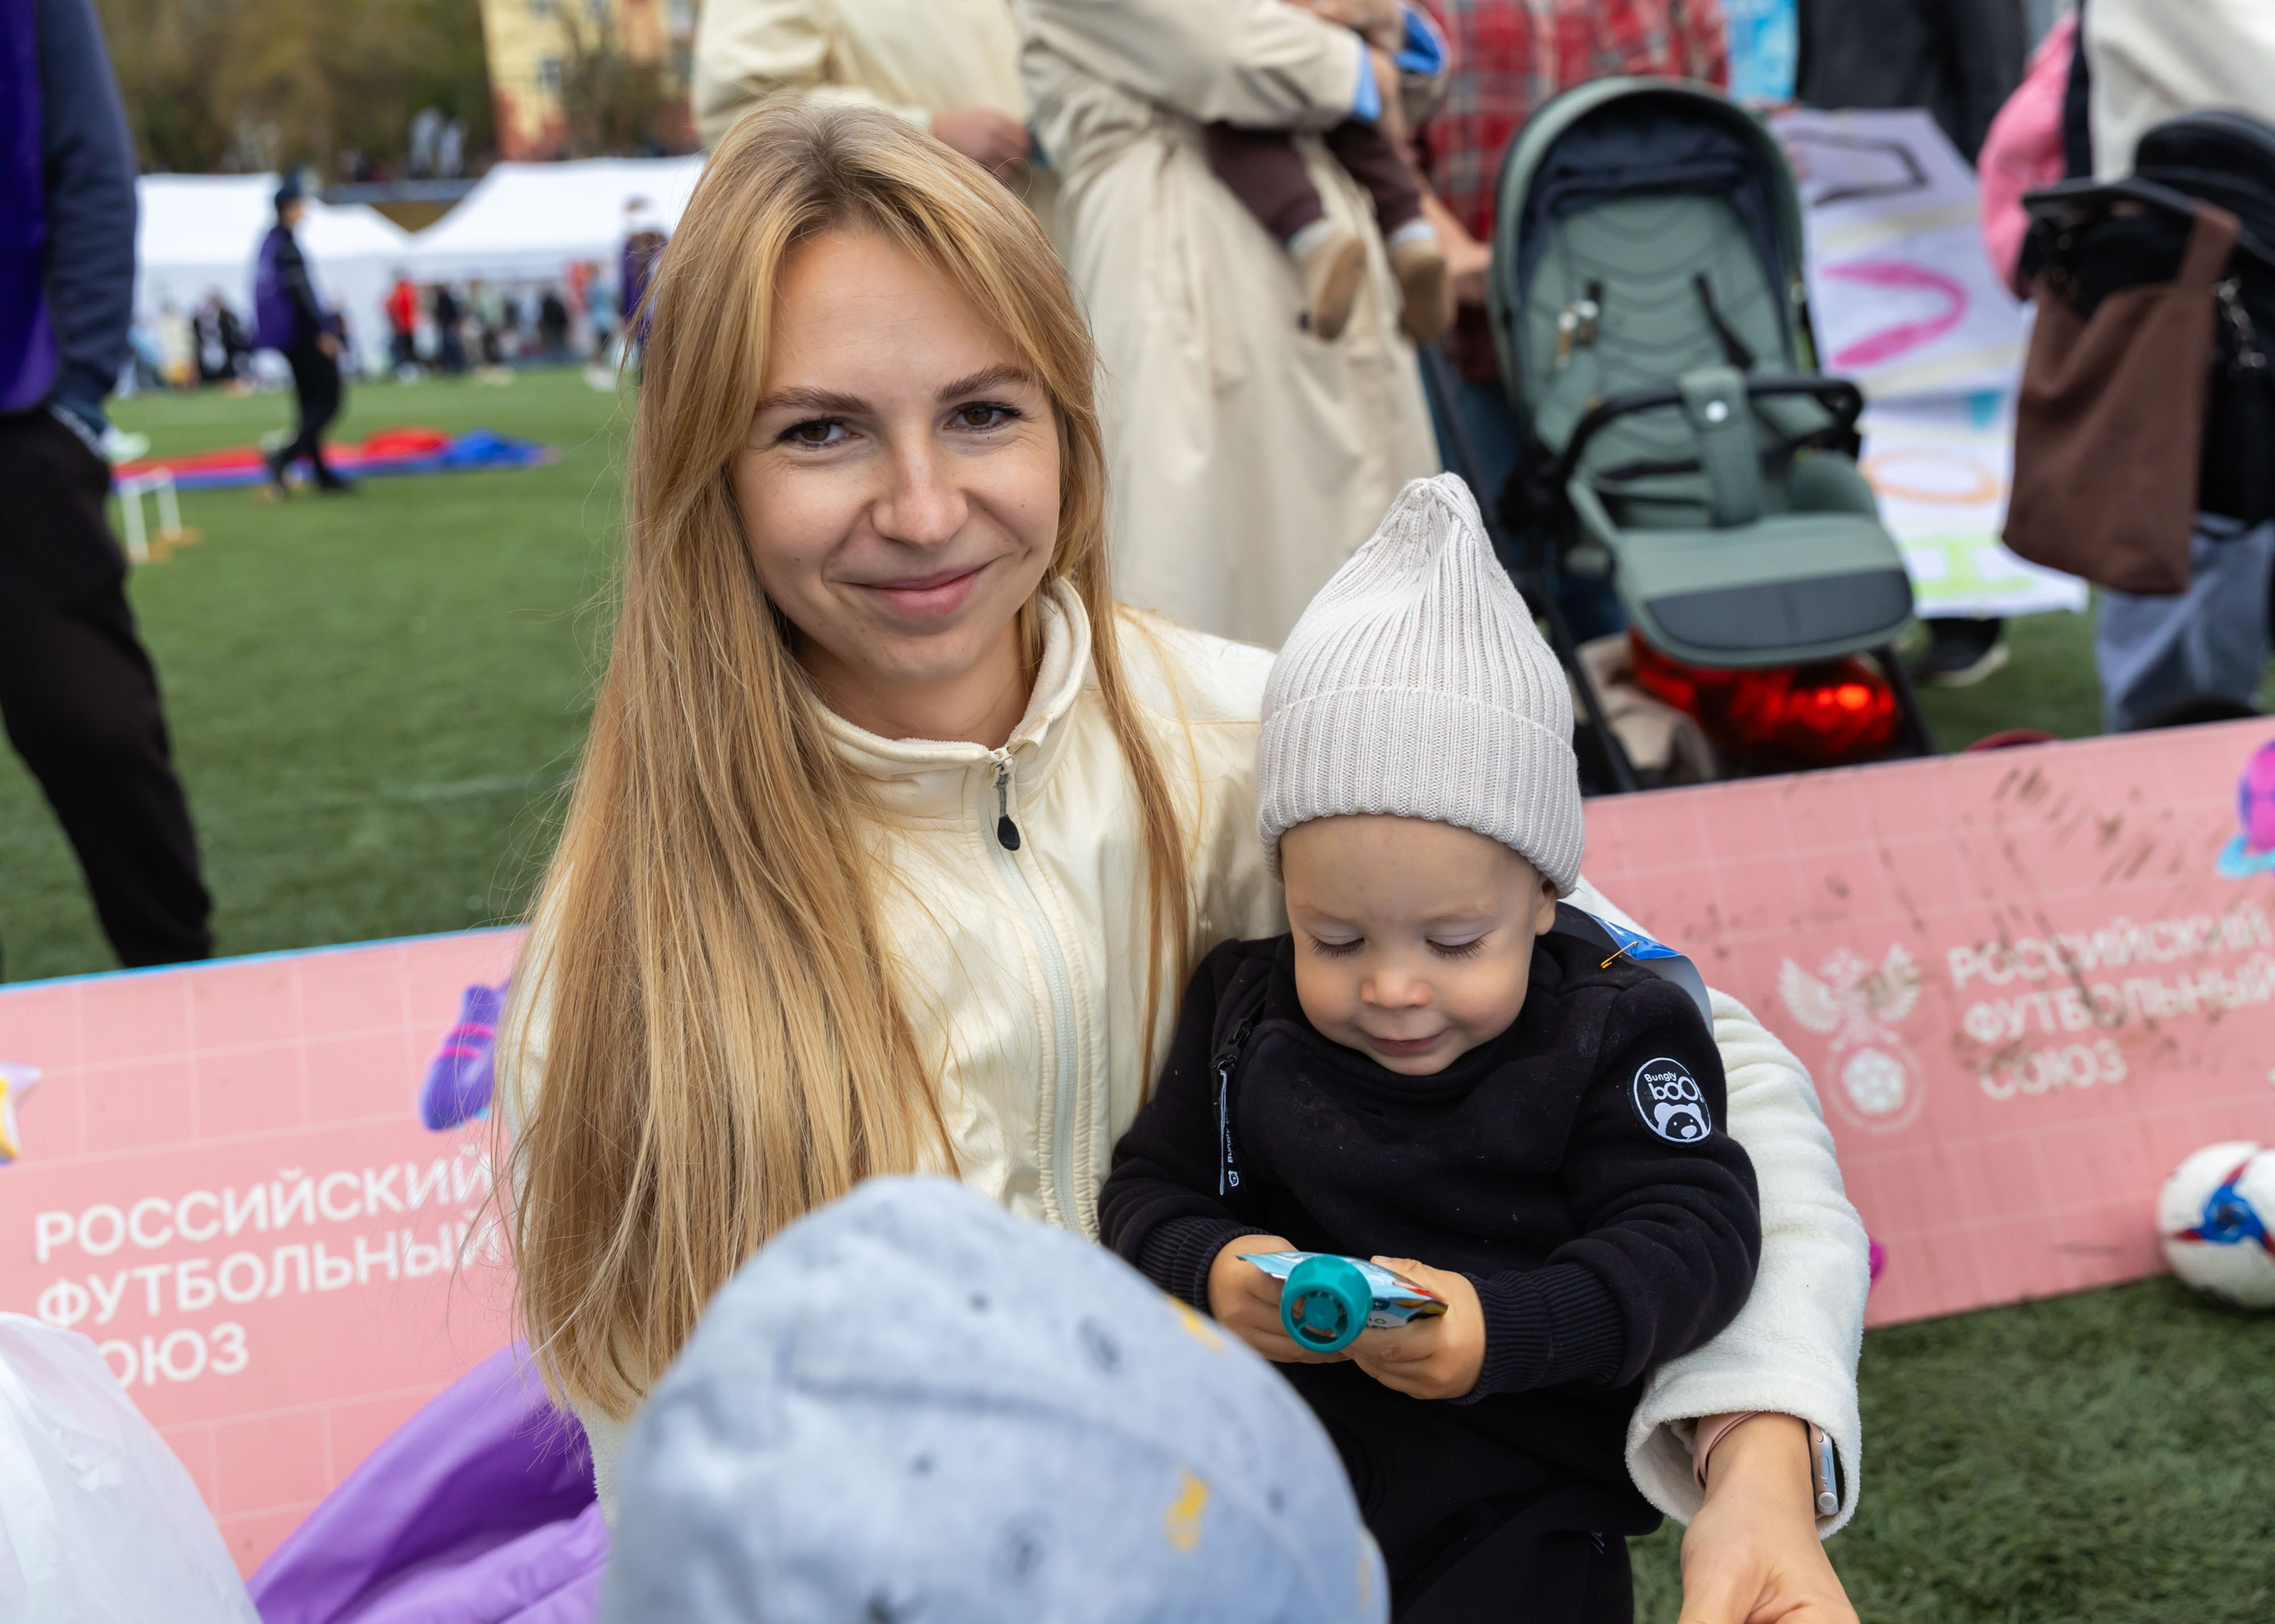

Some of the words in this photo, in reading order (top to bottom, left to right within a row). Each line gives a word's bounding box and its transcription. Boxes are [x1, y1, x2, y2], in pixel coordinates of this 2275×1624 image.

[1946, 897, 2273, 990] РОССИЙСКИЙ
[1643, 1071, 1678, 1083] Bungly
[1978, 1038, 2128, 1102] СОЮЗ
[34, 1142, 494, 1265] РОССИЙСКИЙ
[36, 1208, 501, 1330] ФУТБОЛЬНЫЙ
[96, 1321, 250, 1389] ОЮЗ
